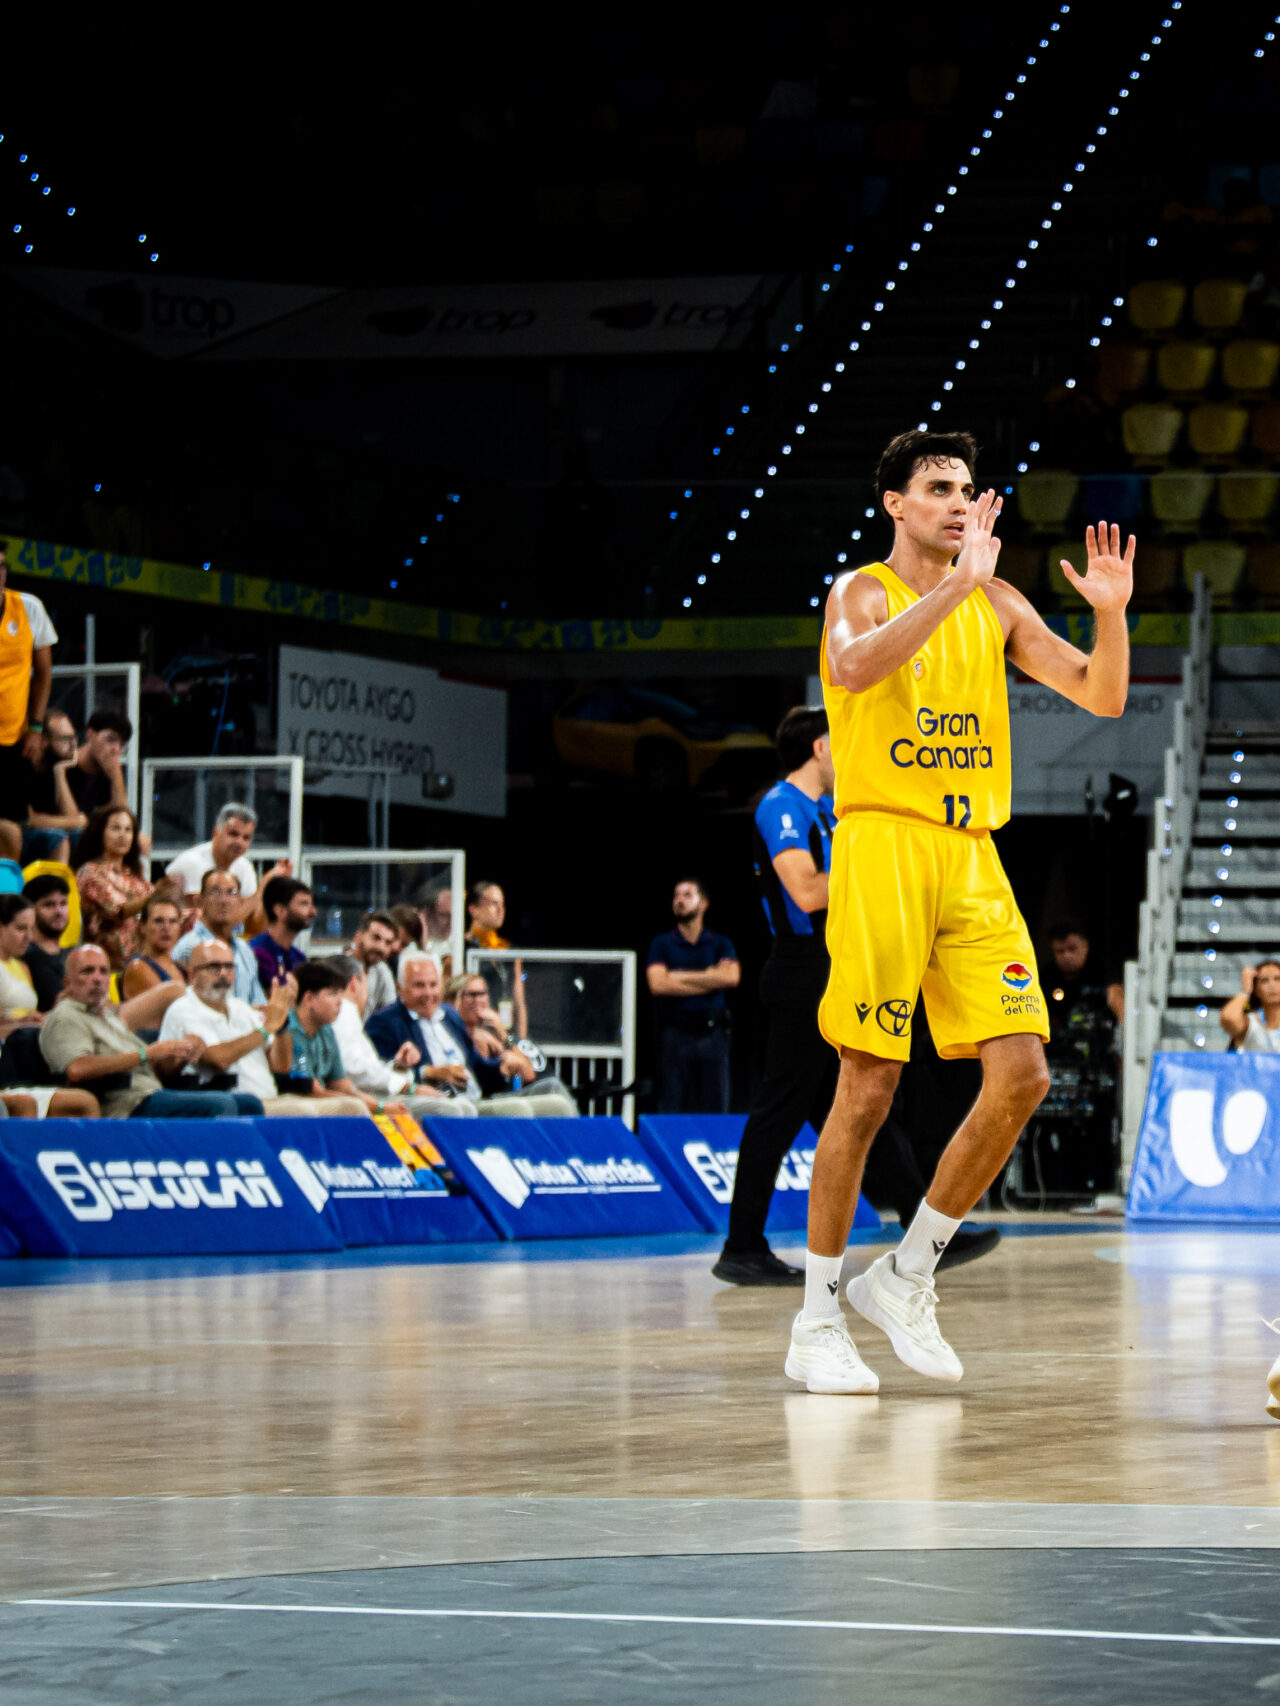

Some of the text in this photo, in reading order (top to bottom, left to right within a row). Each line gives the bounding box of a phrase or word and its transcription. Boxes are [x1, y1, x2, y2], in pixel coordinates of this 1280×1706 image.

[152, 287, 234, 338] trop
[438, 309, 535, 334] trop
[289, 672, 416, 723] TOYOTA AYGO
[917, 707, 980, 736] Gran
[304, 729, 367, 767] CROSS
[1004, 1004, 1023, 1016] del
